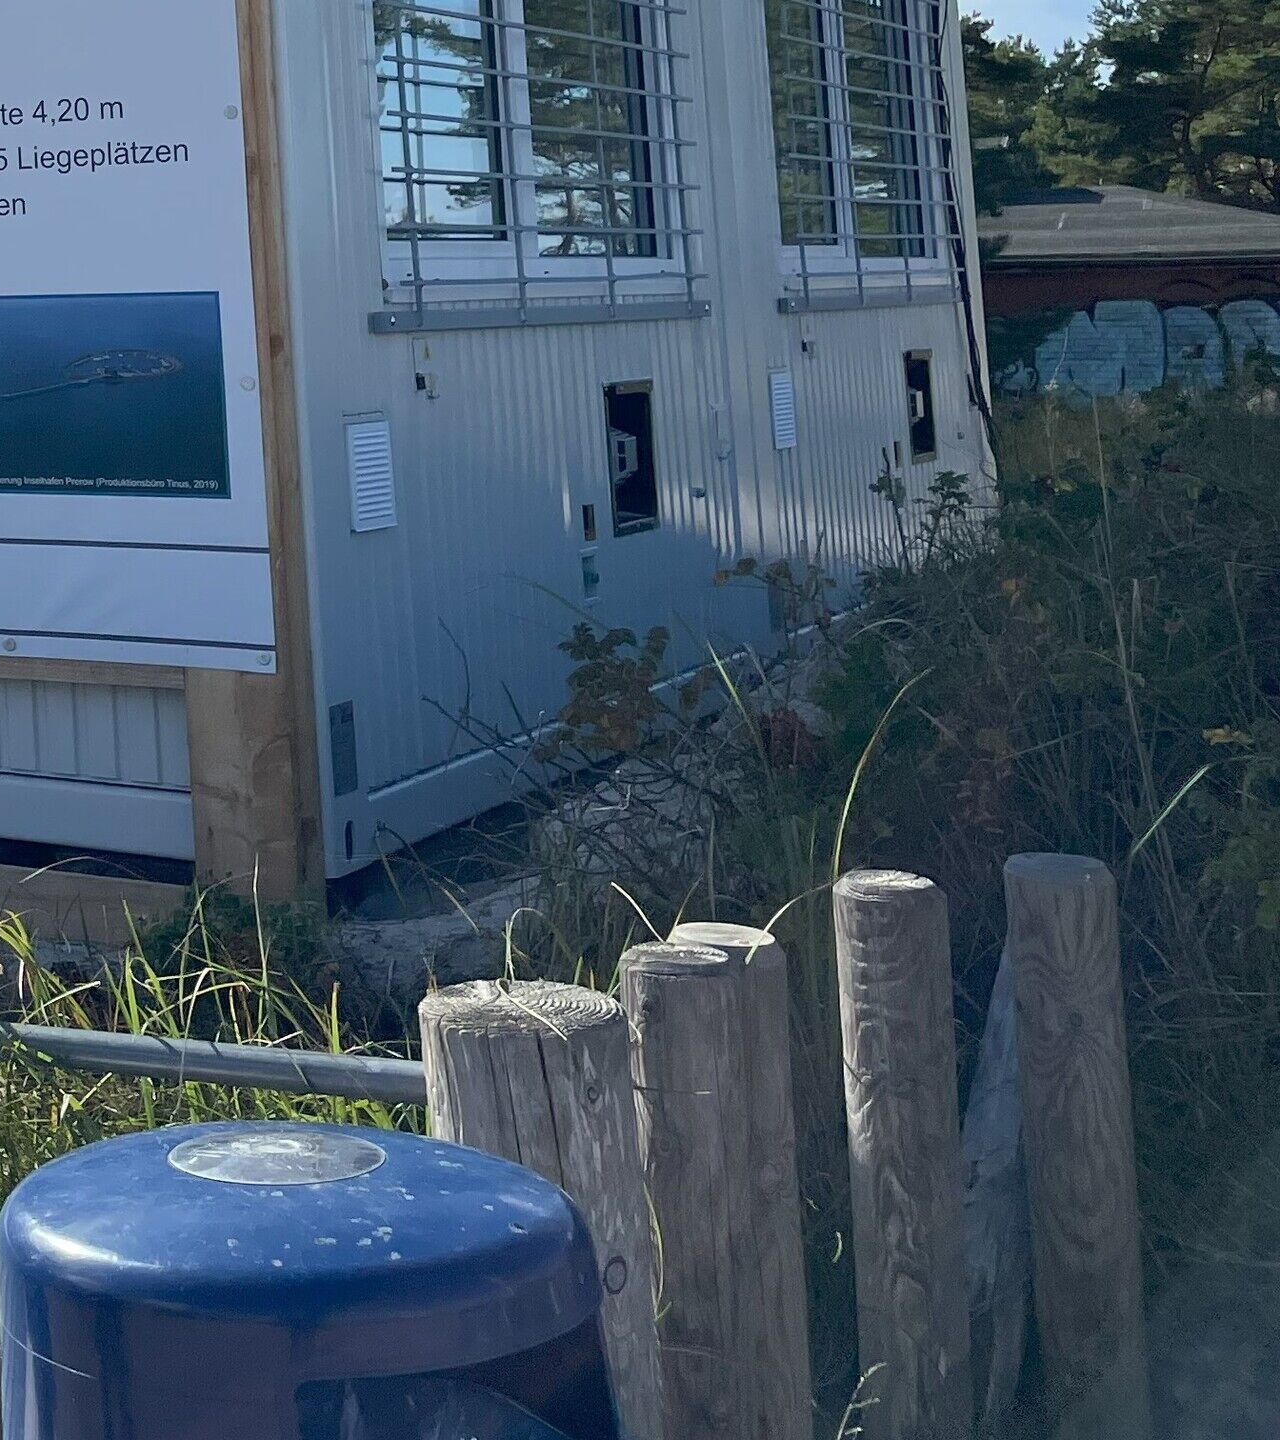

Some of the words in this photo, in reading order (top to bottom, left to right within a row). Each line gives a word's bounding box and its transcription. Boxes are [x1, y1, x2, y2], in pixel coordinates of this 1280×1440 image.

[31, 97, 89, 127] 4,20
[99, 101, 124, 120] m
[17, 141, 189, 175] Liegeplätzen
